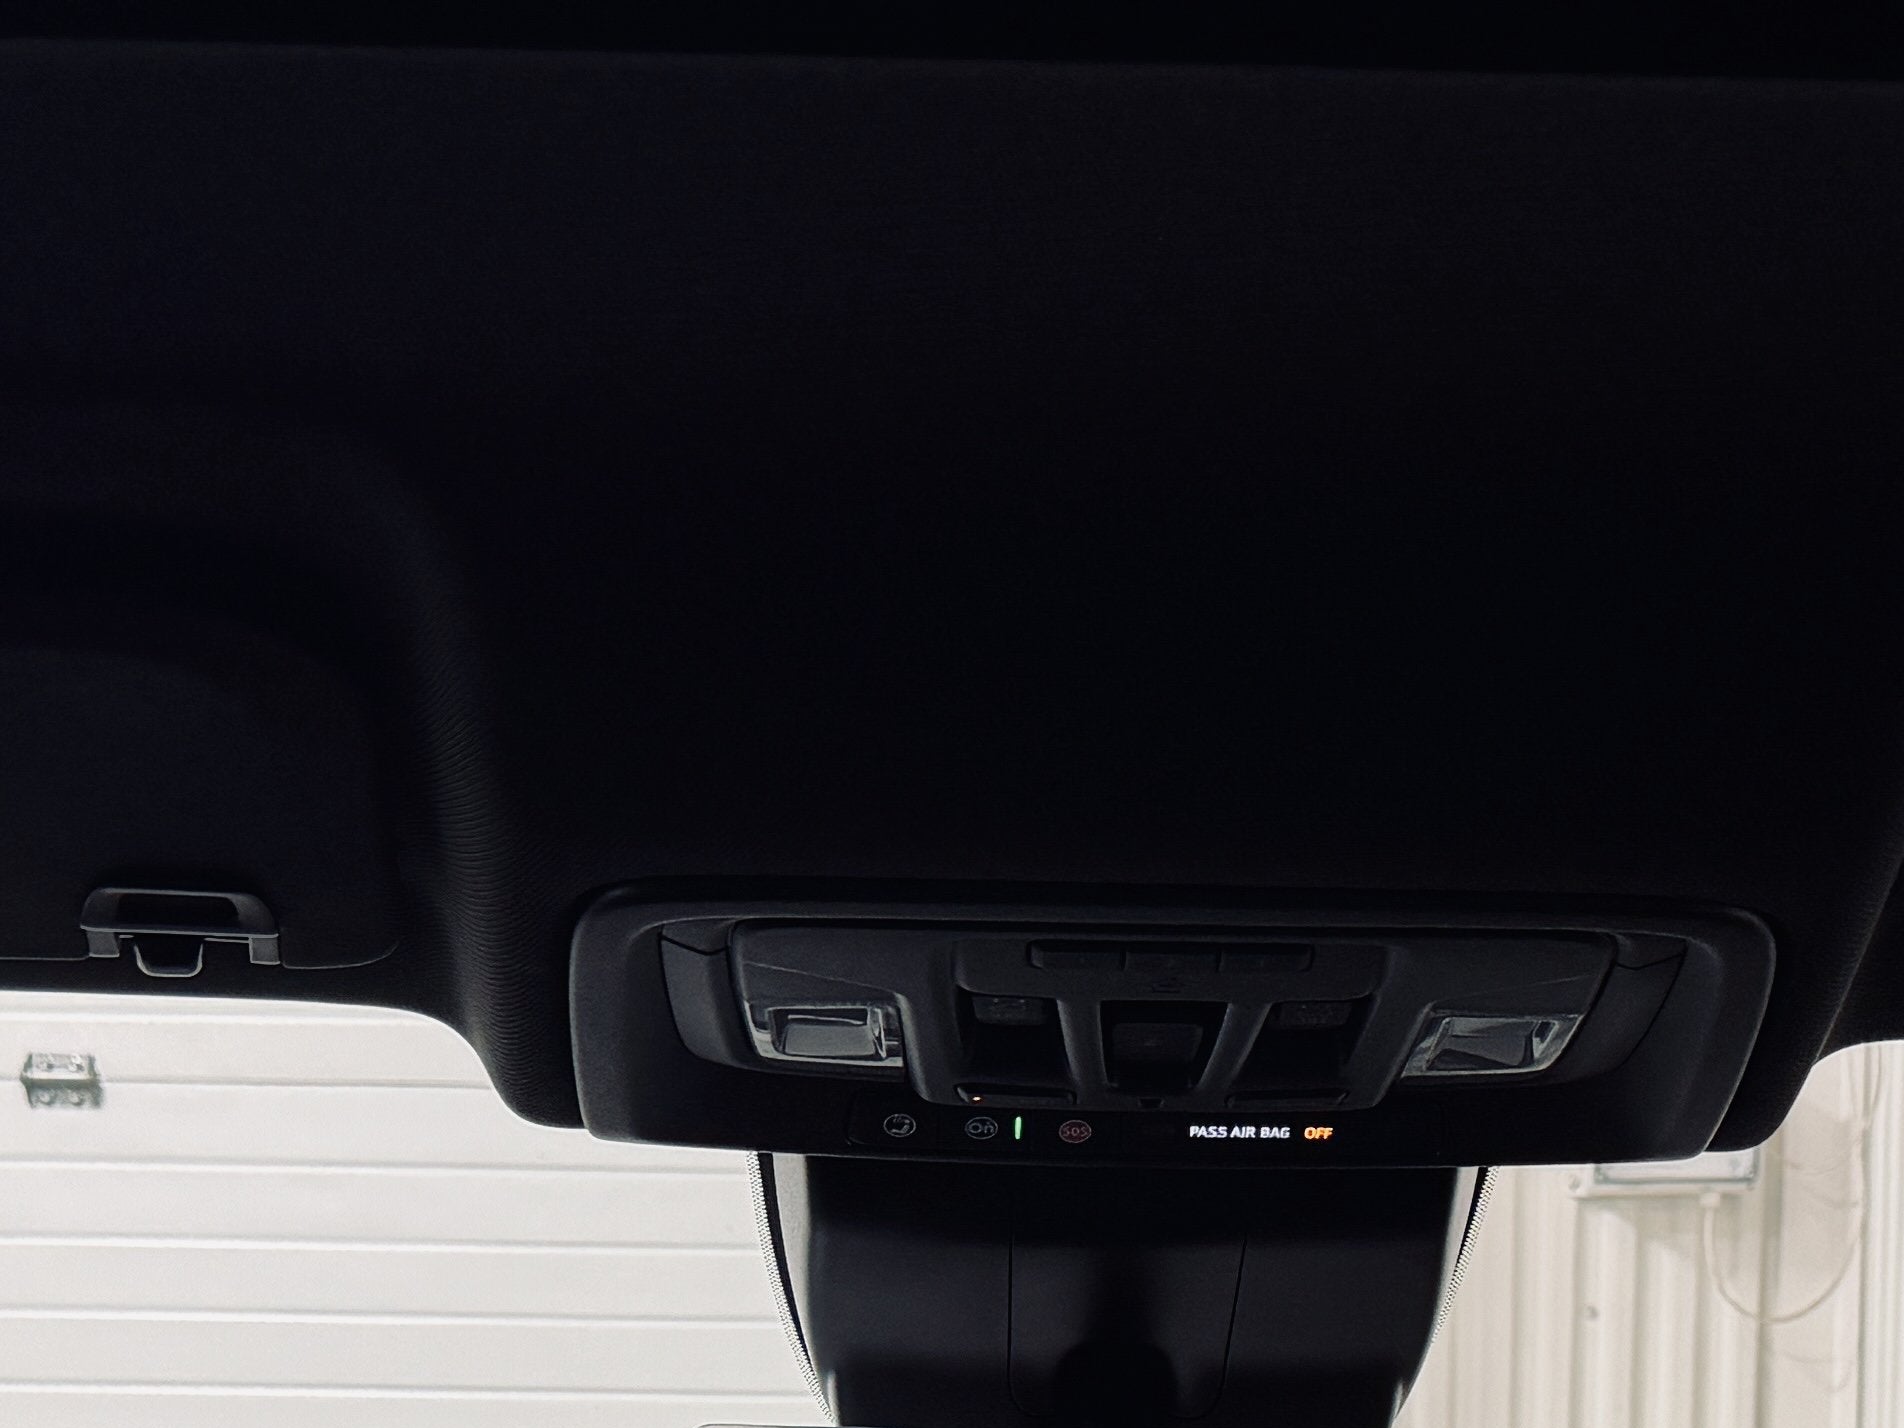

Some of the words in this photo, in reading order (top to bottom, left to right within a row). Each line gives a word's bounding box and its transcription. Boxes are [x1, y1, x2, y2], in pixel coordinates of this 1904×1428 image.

[1189, 1124, 1228, 1138] PASS
[1230, 1125, 1257, 1139] AIR
[1260, 1126, 1291, 1139] BAG
[1304, 1127, 1334, 1140] OFF
